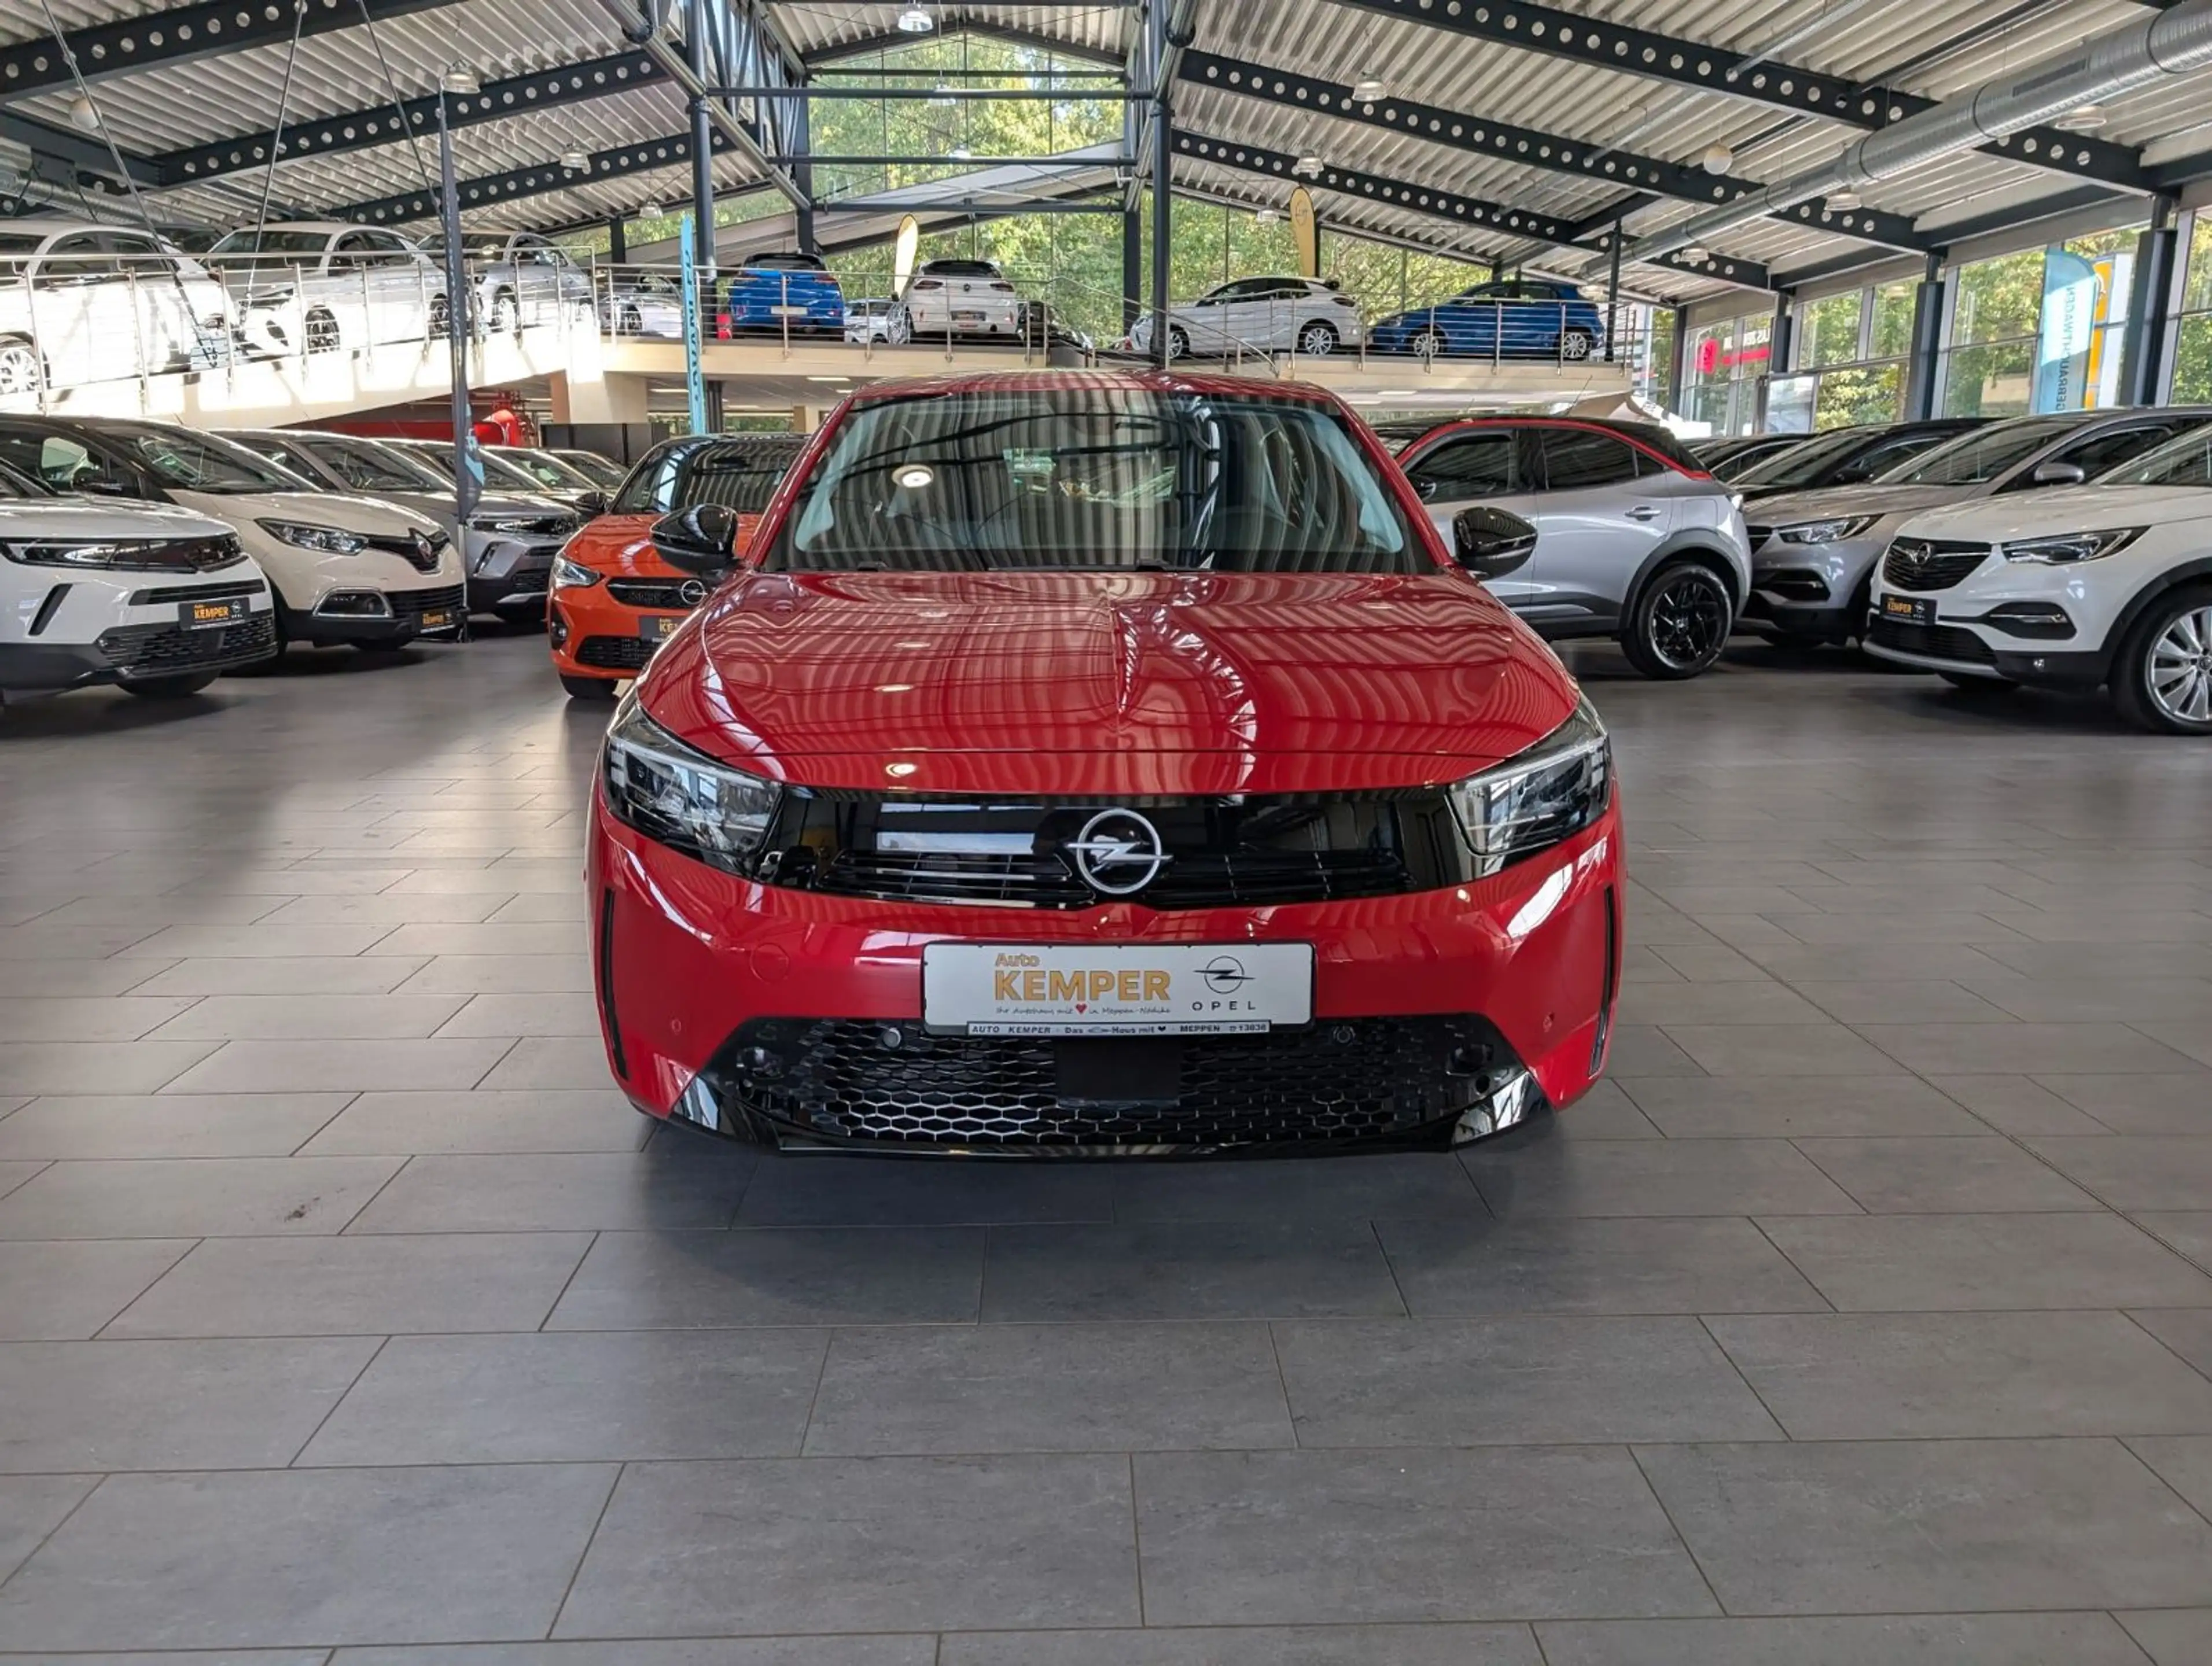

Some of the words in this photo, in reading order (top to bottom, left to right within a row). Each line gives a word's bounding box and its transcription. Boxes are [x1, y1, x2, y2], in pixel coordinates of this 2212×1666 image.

[194, 606, 229, 620] KEMPER
[995, 952, 1040, 967] Auto
[995, 970, 1171, 1001] KEMPER
[1191, 1000, 1256, 1011] OPEL
[1139, 1026, 1155, 1034] mit
